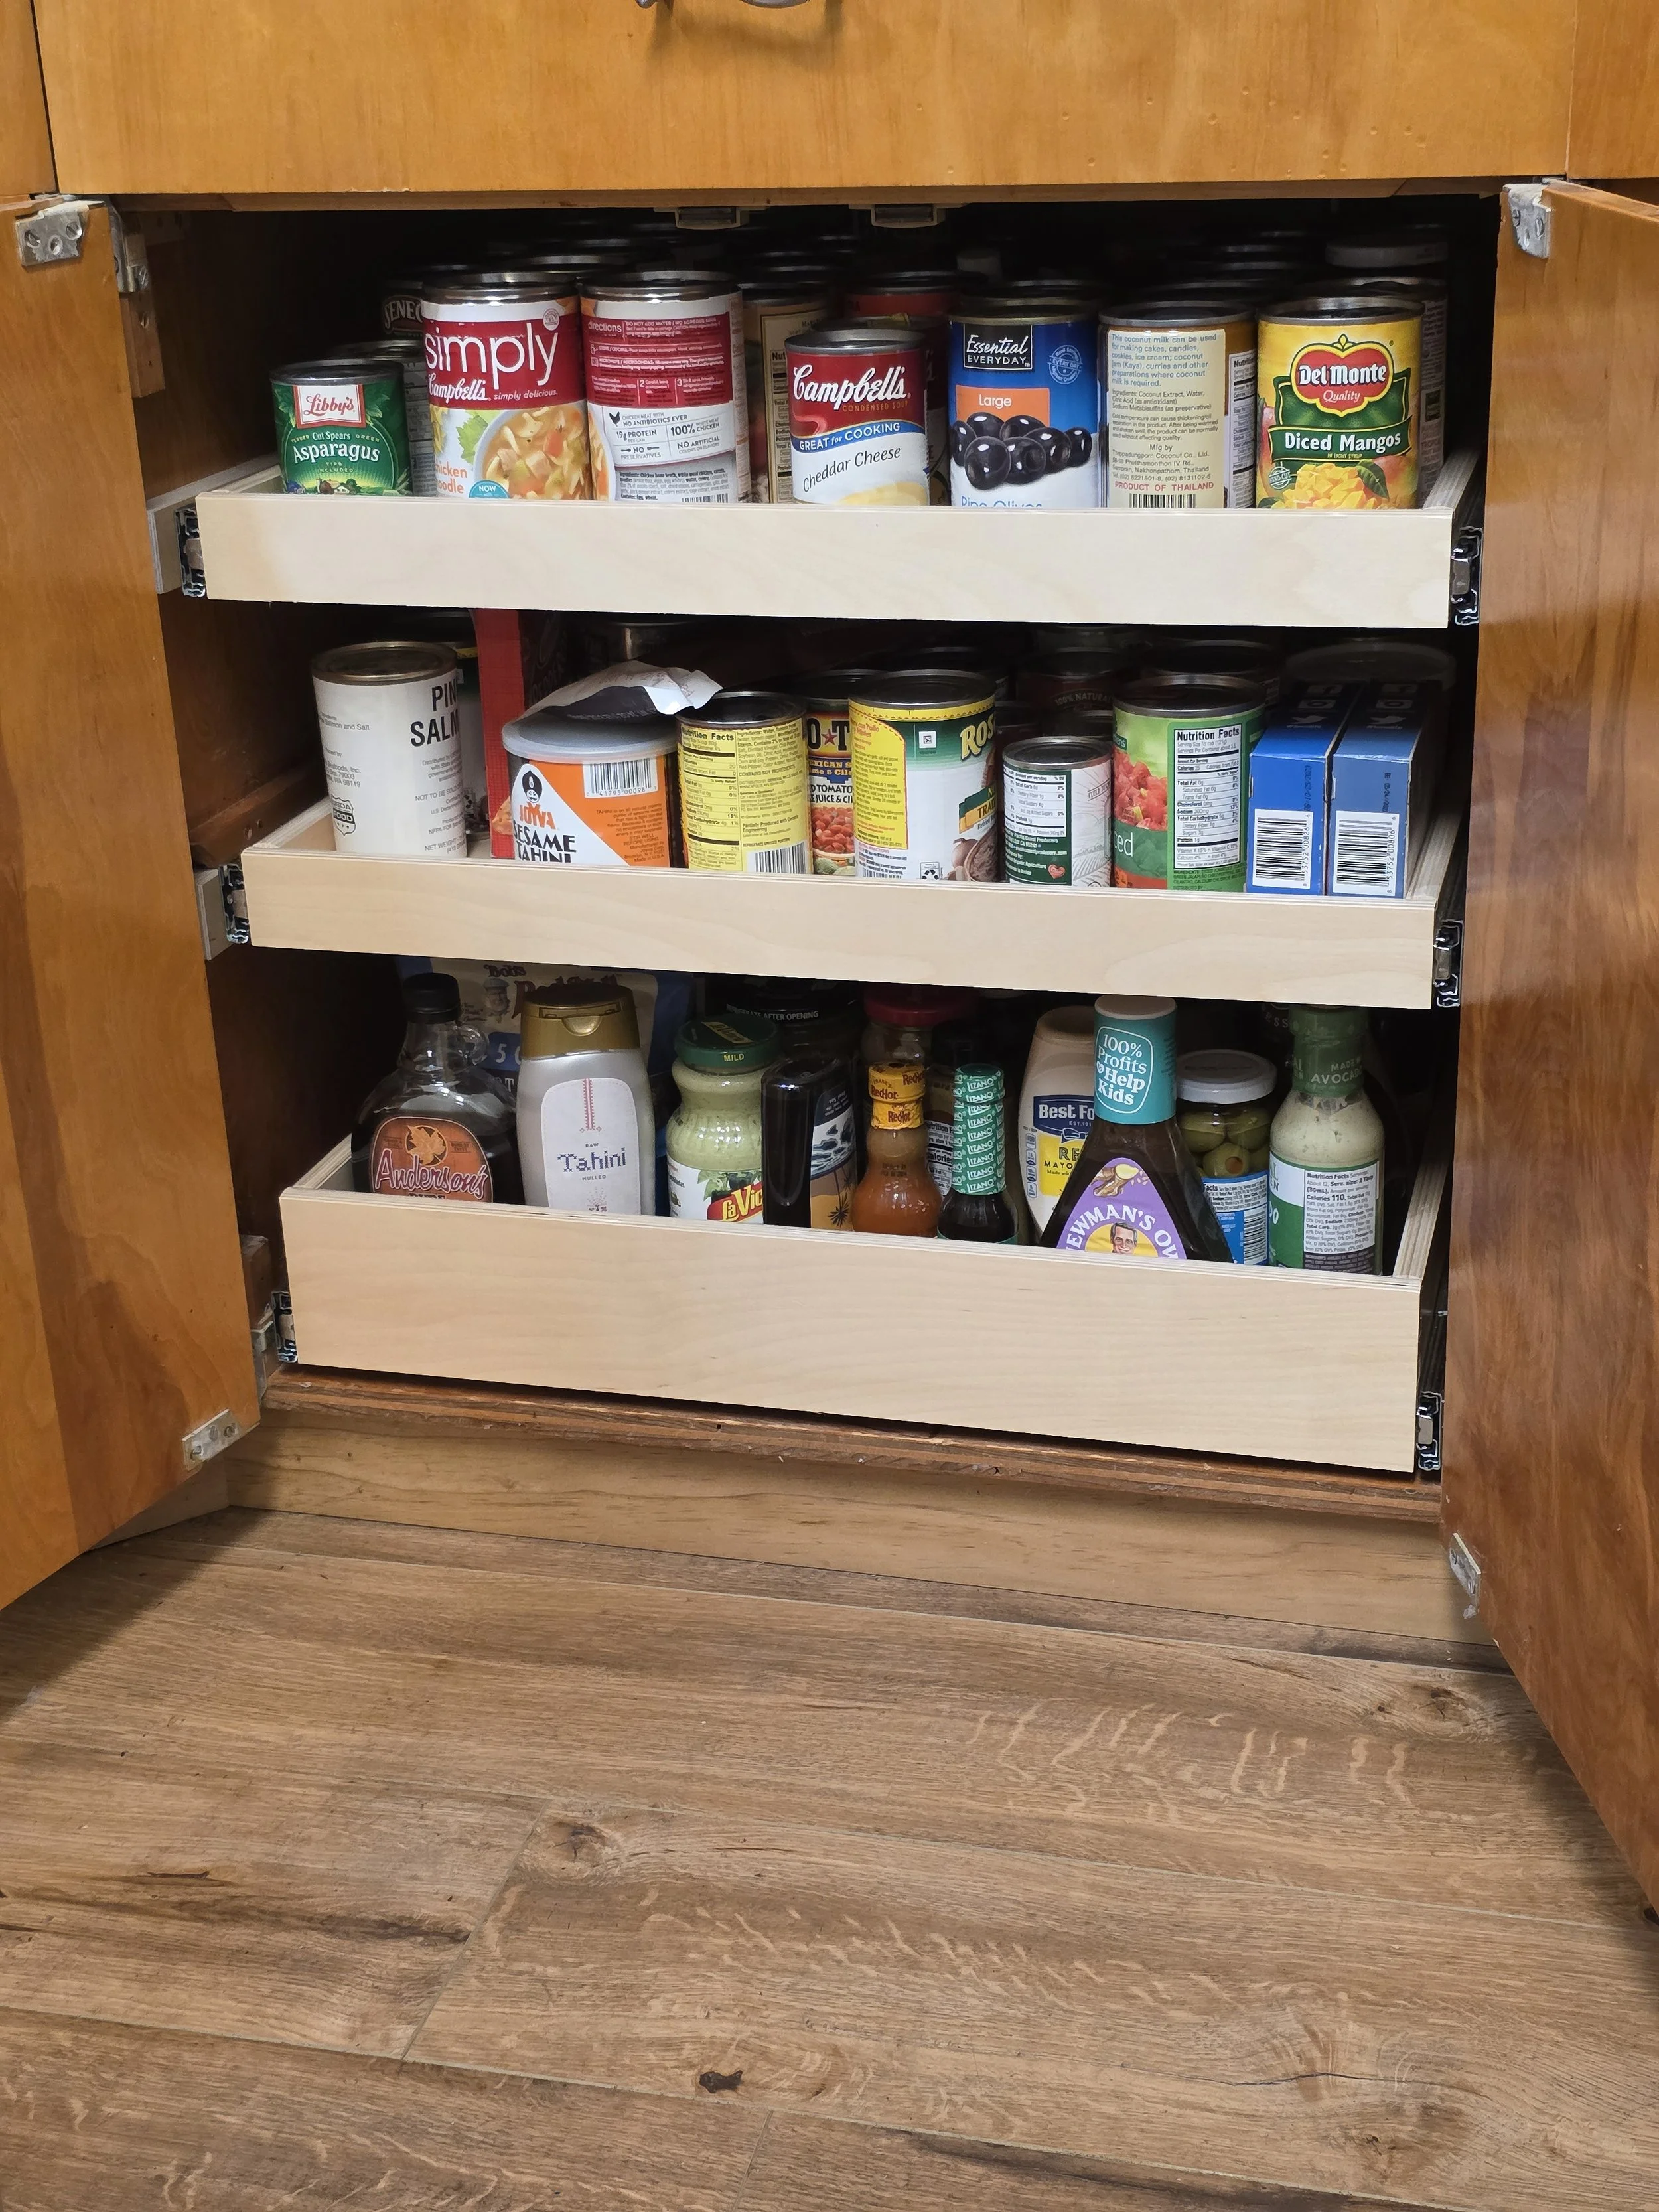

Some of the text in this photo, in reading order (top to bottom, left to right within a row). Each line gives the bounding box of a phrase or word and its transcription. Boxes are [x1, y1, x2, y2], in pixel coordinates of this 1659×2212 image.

[588, 321, 622, 333] directions
[966, 334, 1028, 354] Essential
[1120, 344, 1142, 352] making
[425, 323, 558, 390] simply
[967, 355, 1027, 365] EVERYDAY
[1299, 364, 1387, 386] Del Monte
[428, 373, 489, 404] Campbell's
[793, 364, 908, 410] Campbell's
[494, 390, 522, 402] simply
[979, 394, 1012, 409] Large
[1323, 390, 1361, 403] Quality
[303, 394, 354, 416] Libby's
[892, 400, 908, 409] SOUP
[634, 417, 670, 426] ANTIBIOTICS
[697, 423, 719, 432] CHICKEN
[326, 431, 351, 441] Spears
[616, 429, 657, 441] 19g PROTEIN
[670, 423, 695, 436] 100%
[799, 422, 901, 451] GREAT for COOKING
[691, 436, 720, 446] ARTIFICIAL
[1285, 433, 1402, 453] Diced Mangos
[293, 443, 380, 463] Asparagus
[803, 447, 901, 492] Cheddar Cheese
[1115, 481, 1149, 490] PRODUCT
[1171, 482, 1214, 491] THAILAND
[1177, 727, 1240, 741] Nutrition Facts
[415, 792, 428, 802] NOT
[333, 811, 353, 822] FOOD
[513, 820, 577, 853] SESAME
[516, 841, 571, 863] TAHINI
[786, 1011, 819, 1020] OPENING
[1103, 1034, 1143, 1059] 100%
[1097, 1046, 1147, 1075] Profits
[967, 1078, 994, 1092] LIZANO
[1105, 1068, 1145, 1094] Help
[966, 1091, 994, 1103] LIZANO
[1098, 1080, 1135, 1106] Kids
[1039, 1104, 1076, 1119] Best
[967, 1114, 993, 1129] LIZANO
[967, 1127, 993, 1142] LIZANO
[967, 1140, 993, 1155] LIZANO
[557, 1147, 626, 1172] Tahini
[967, 1153, 994, 1167] LIZANO
[375, 1148, 488, 1199] Anderson's
[967, 1166, 994, 1180] LIZANO
[967, 1179, 995, 1193] LIZANO
[723, 1200, 739, 1222] La
